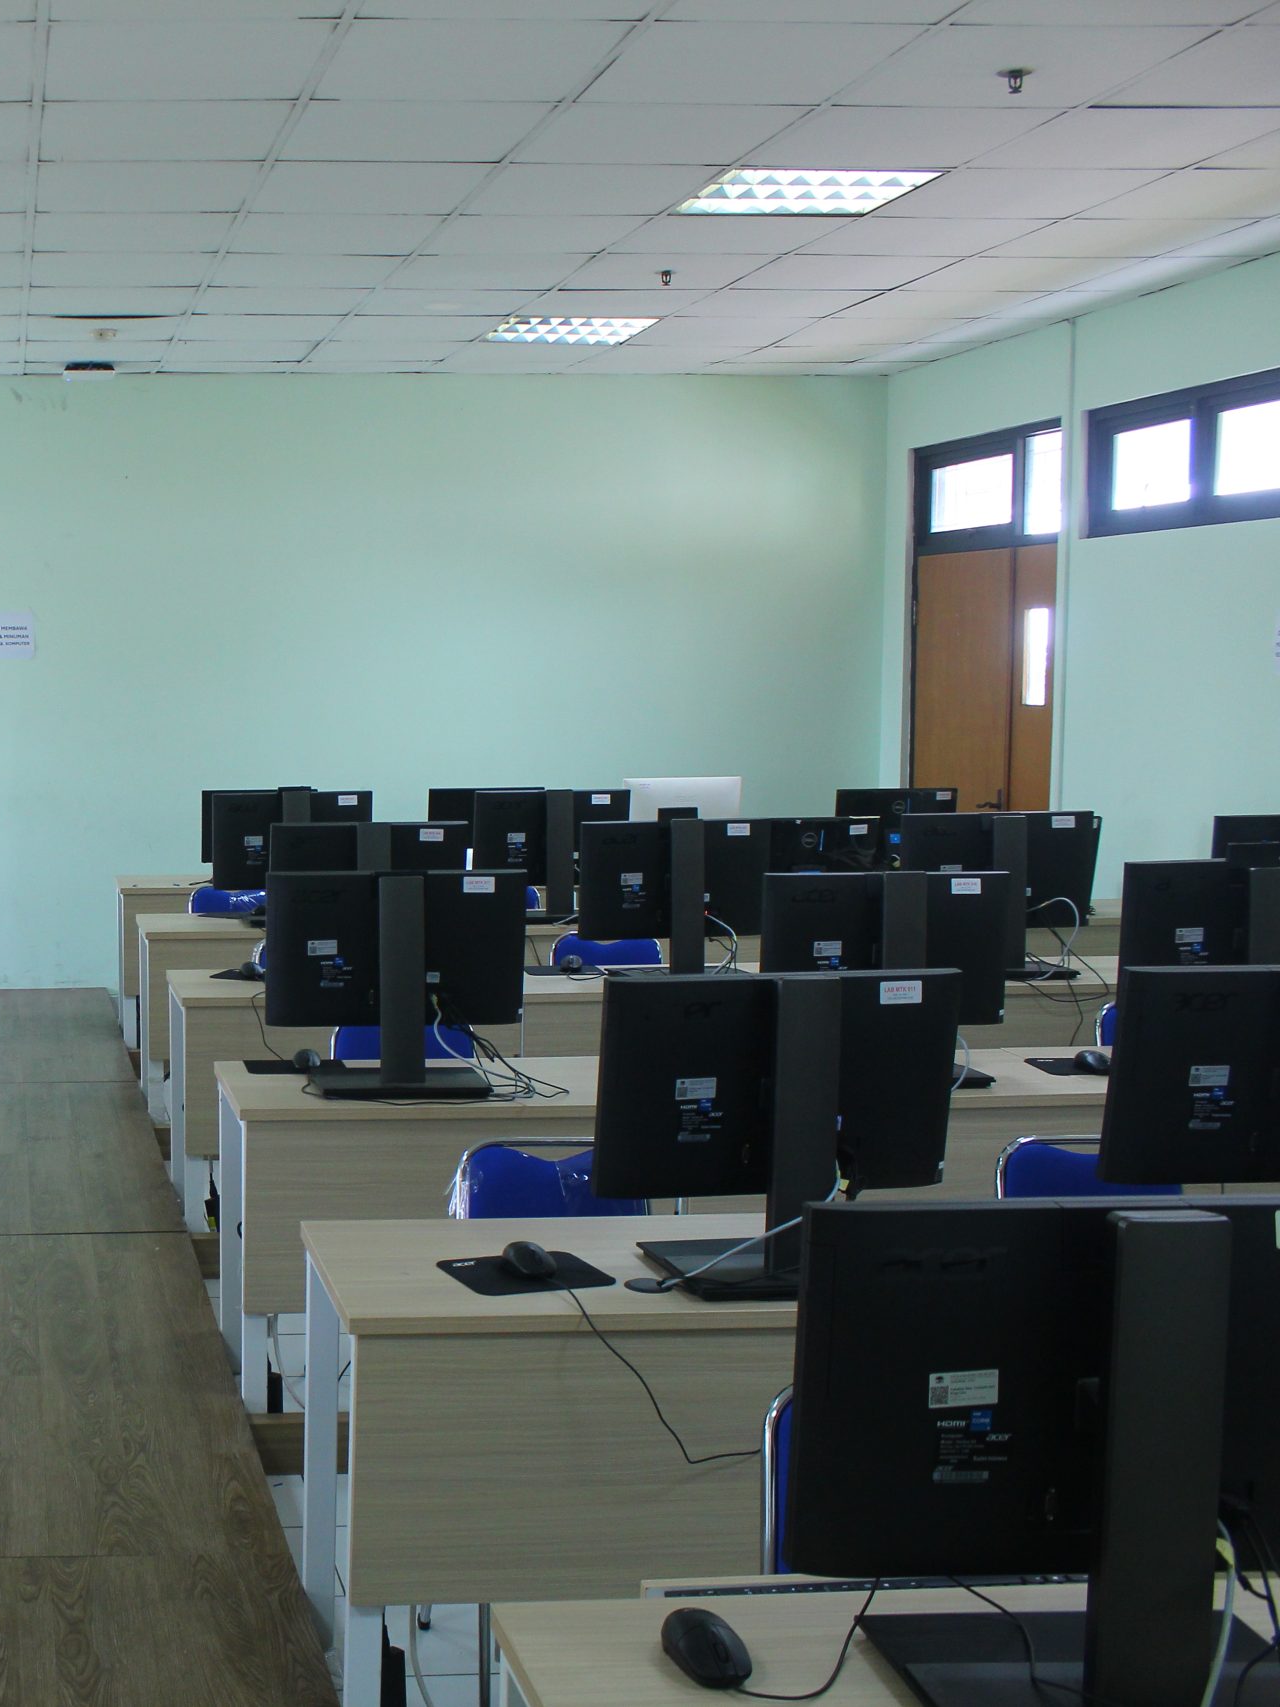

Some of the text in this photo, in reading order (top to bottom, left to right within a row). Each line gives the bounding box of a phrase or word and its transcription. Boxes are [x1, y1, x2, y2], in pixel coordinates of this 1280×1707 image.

[884, 986, 895, 994] LAB
[895, 985, 906, 993] MTK
[985, 1433, 1012, 1442] acer
